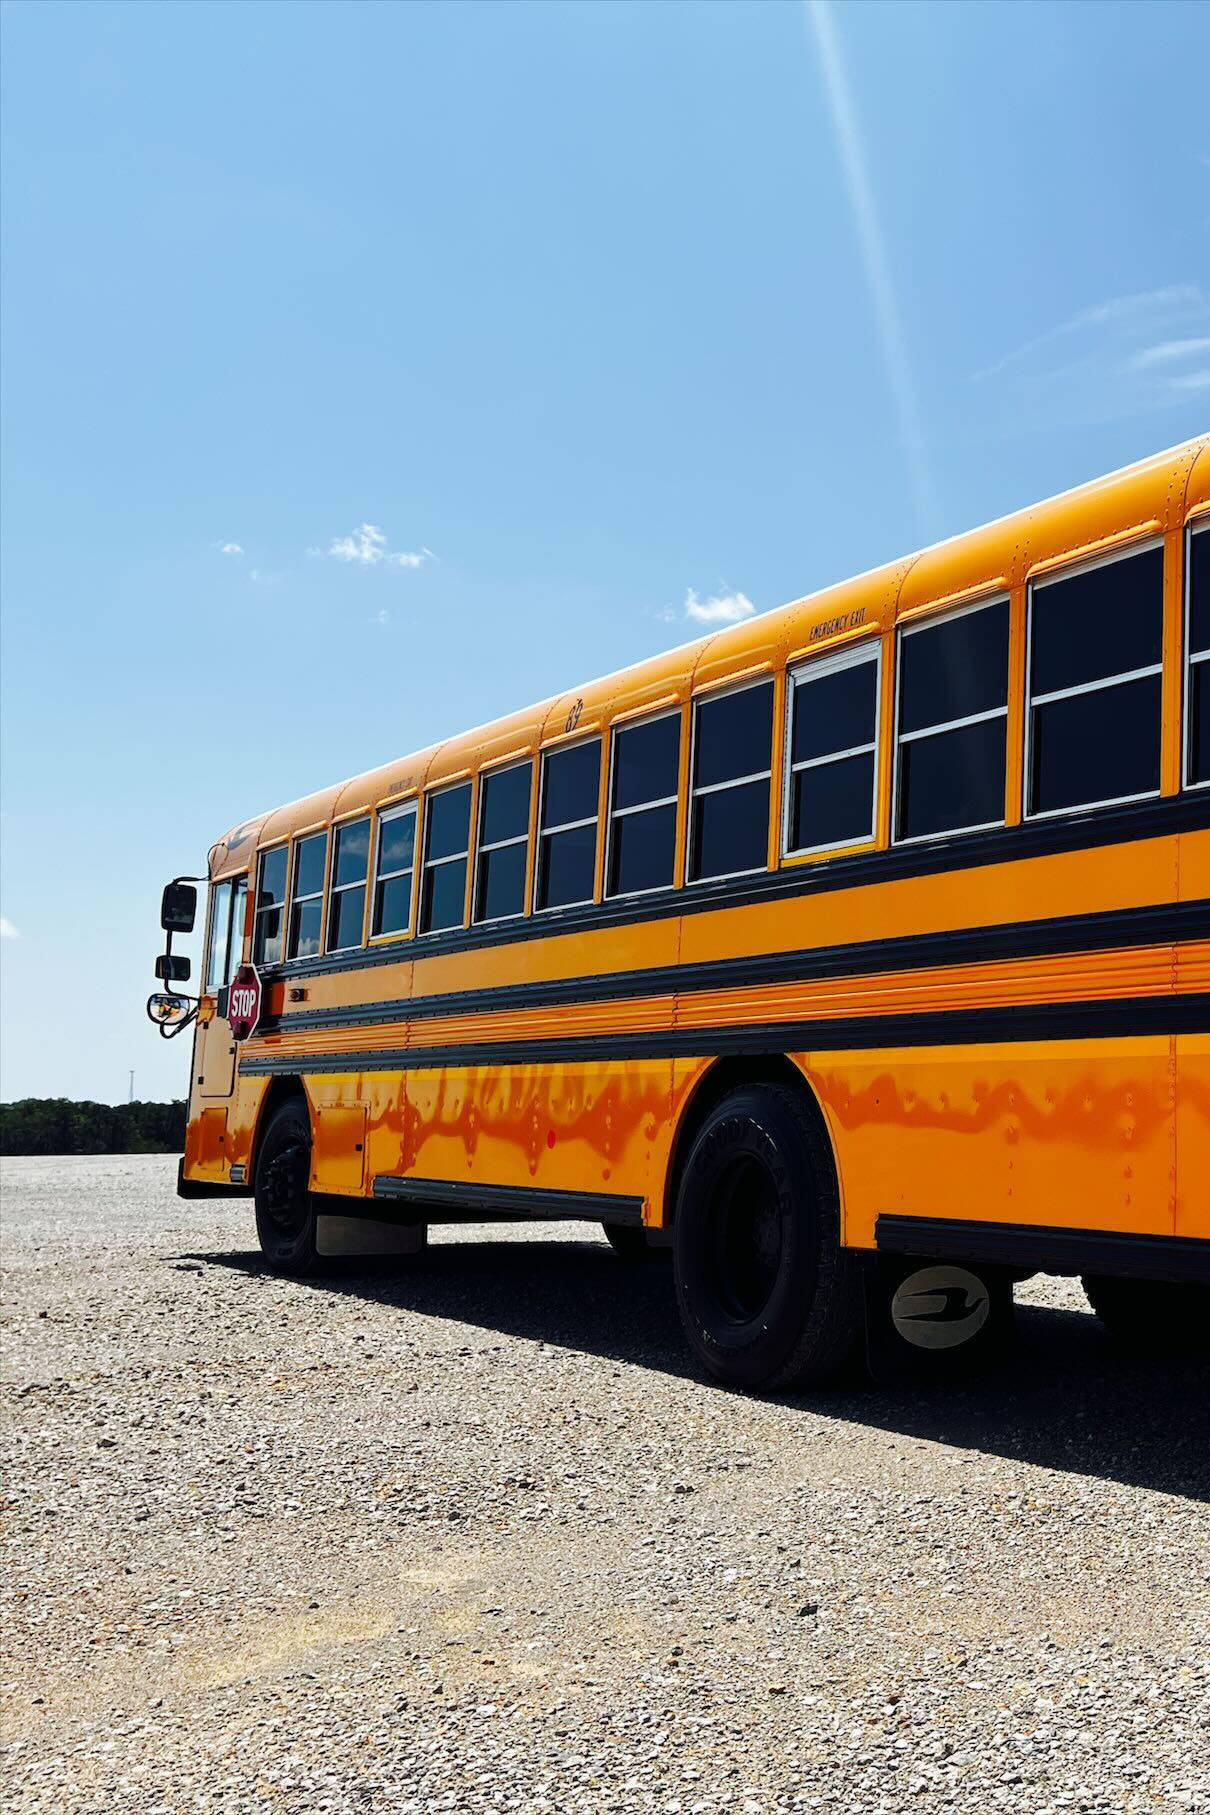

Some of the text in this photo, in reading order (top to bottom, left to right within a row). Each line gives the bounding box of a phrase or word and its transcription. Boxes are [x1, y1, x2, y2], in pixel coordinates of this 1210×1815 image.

[809, 607, 866, 641] EMERGENCY EXIT
[231, 989, 257, 1018] STOP
